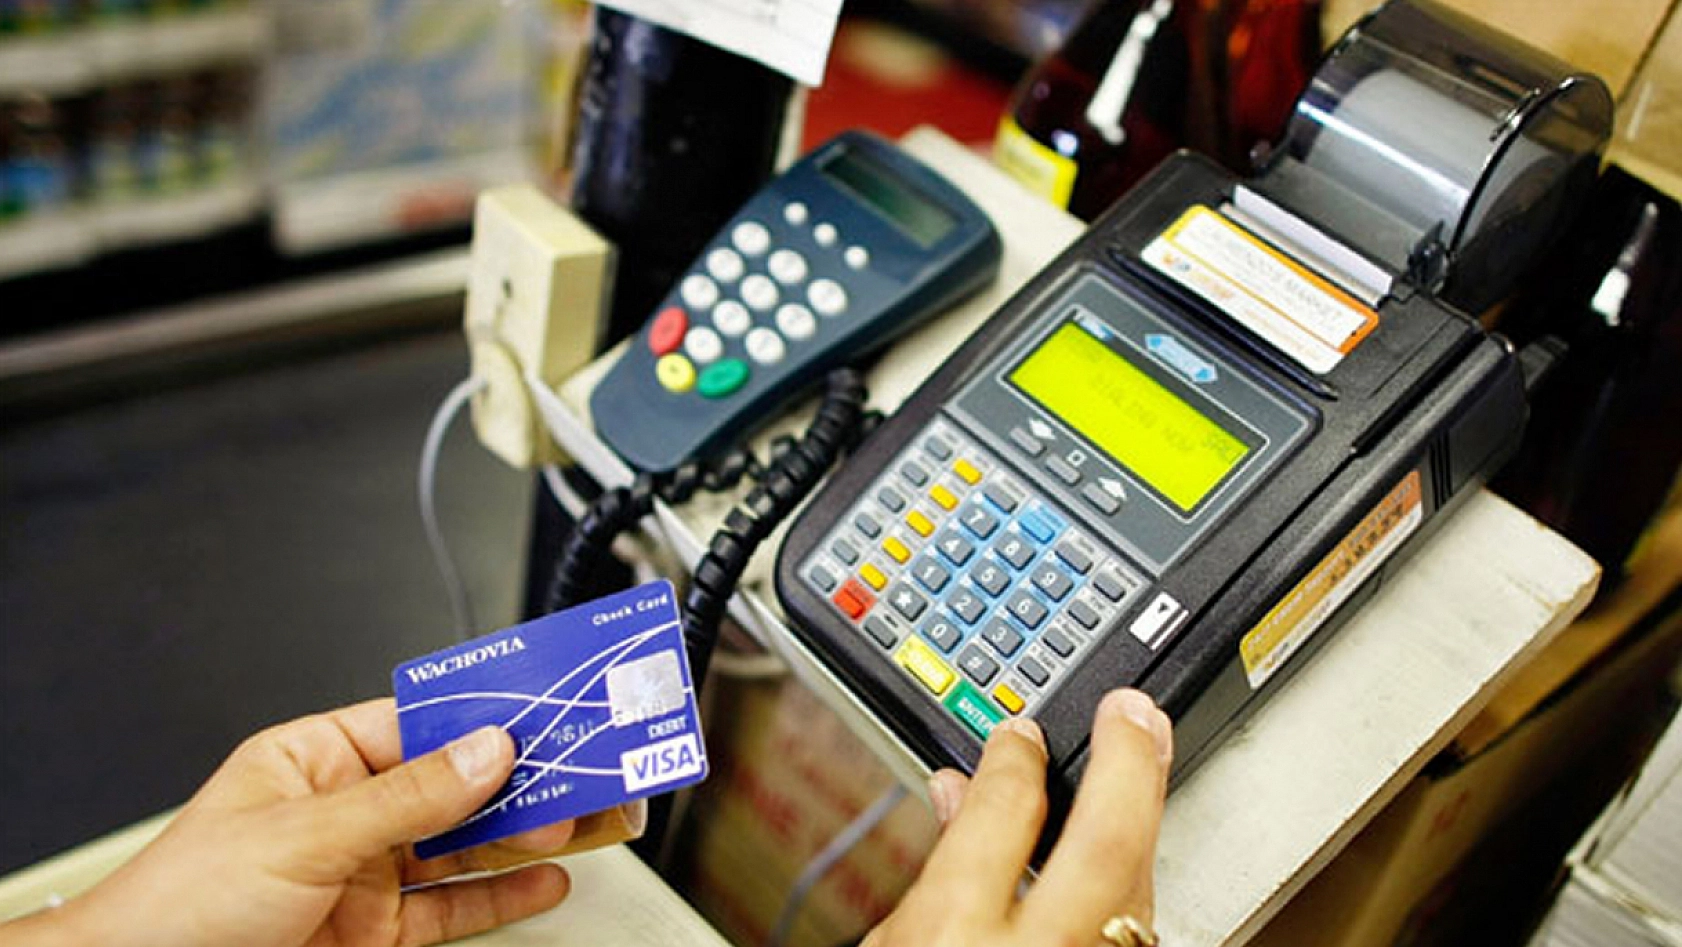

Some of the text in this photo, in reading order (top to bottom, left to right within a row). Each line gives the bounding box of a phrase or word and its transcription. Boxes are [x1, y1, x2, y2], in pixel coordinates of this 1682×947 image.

[970, 509, 985, 524] 7
[945, 539, 960, 552] 4
[1005, 540, 1020, 556] 8
[923, 566, 936, 579] 1
[981, 567, 996, 582] 5
[1041, 572, 1057, 587] 9
[592, 593, 669, 626] Check Card
[956, 596, 972, 612] 2
[1017, 599, 1031, 613] 6
[932, 624, 947, 638] 0
[992, 627, 1007, 642] 3
[405, 636, 526, 685] WACHOVIA
[648, 716, 688, 739] DEBIT
[631, 743, 695, 781] VISA
